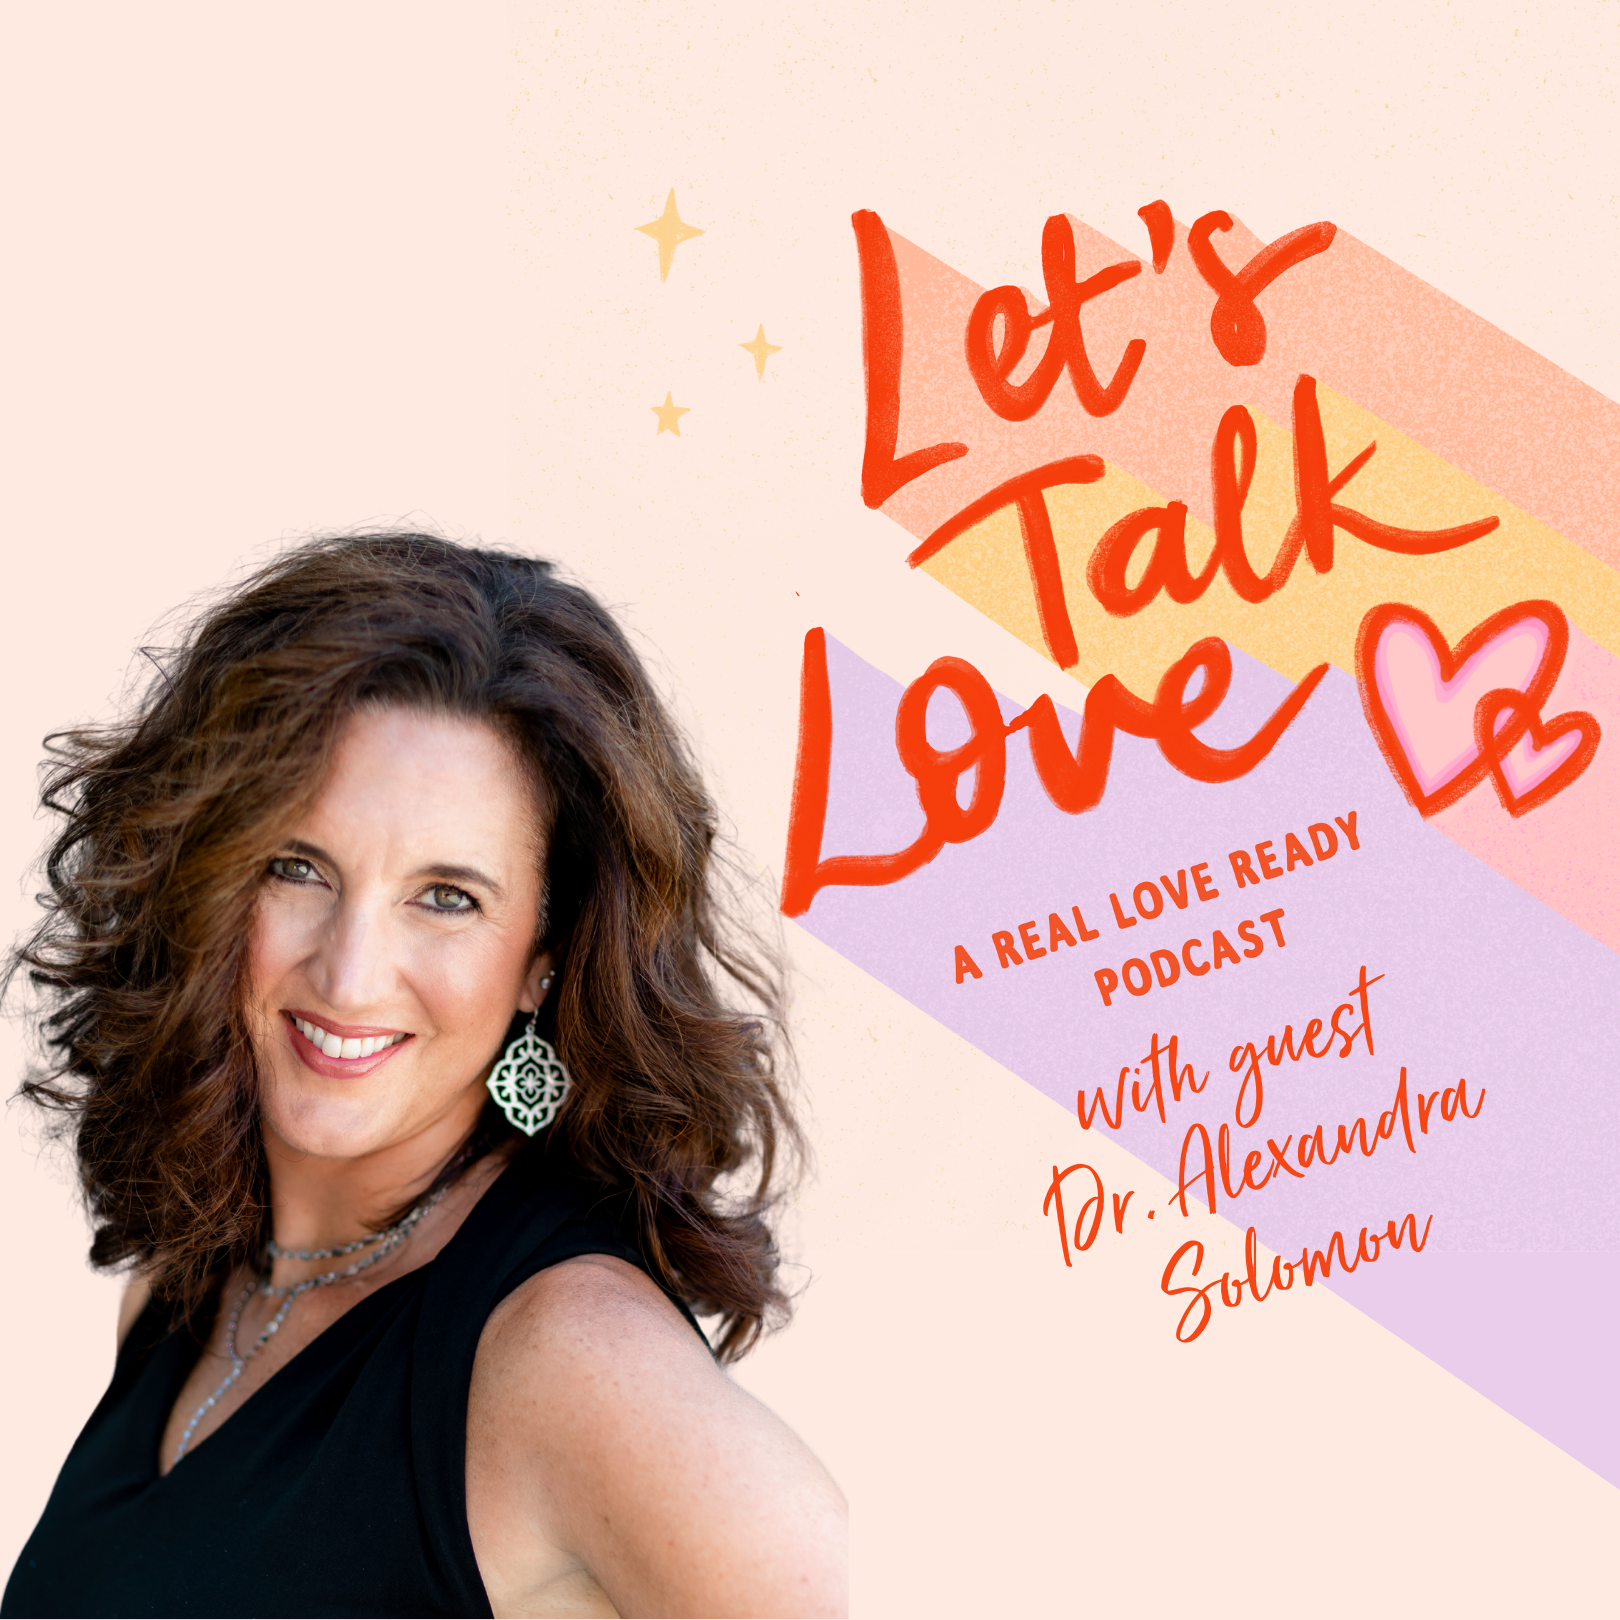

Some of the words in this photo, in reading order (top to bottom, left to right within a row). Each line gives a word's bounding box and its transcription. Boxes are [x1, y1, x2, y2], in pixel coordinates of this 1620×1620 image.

[852, 199, 1337, 510] Let's
[908, 373, 1500, 670] Talk
[780, 626, 1330, 918] Love
[954, 944, 983, 985] A
[991, 905, 1100, 969] REAL
[1109, 862, 1220, 929] LOVE
[1228, 810, 1361, 889] READY
[1093, 908, 1288, 1007] PODCAST
[1077, 1032, 1209, 1131] with
[1229, 965, 1385, 1129] guest
[1042, 1163, 1156, 1268] Dr.
[1168, 1066, 1487, 1217] Alexandra
[1160, 1213, 1433, 1344] Solomon
